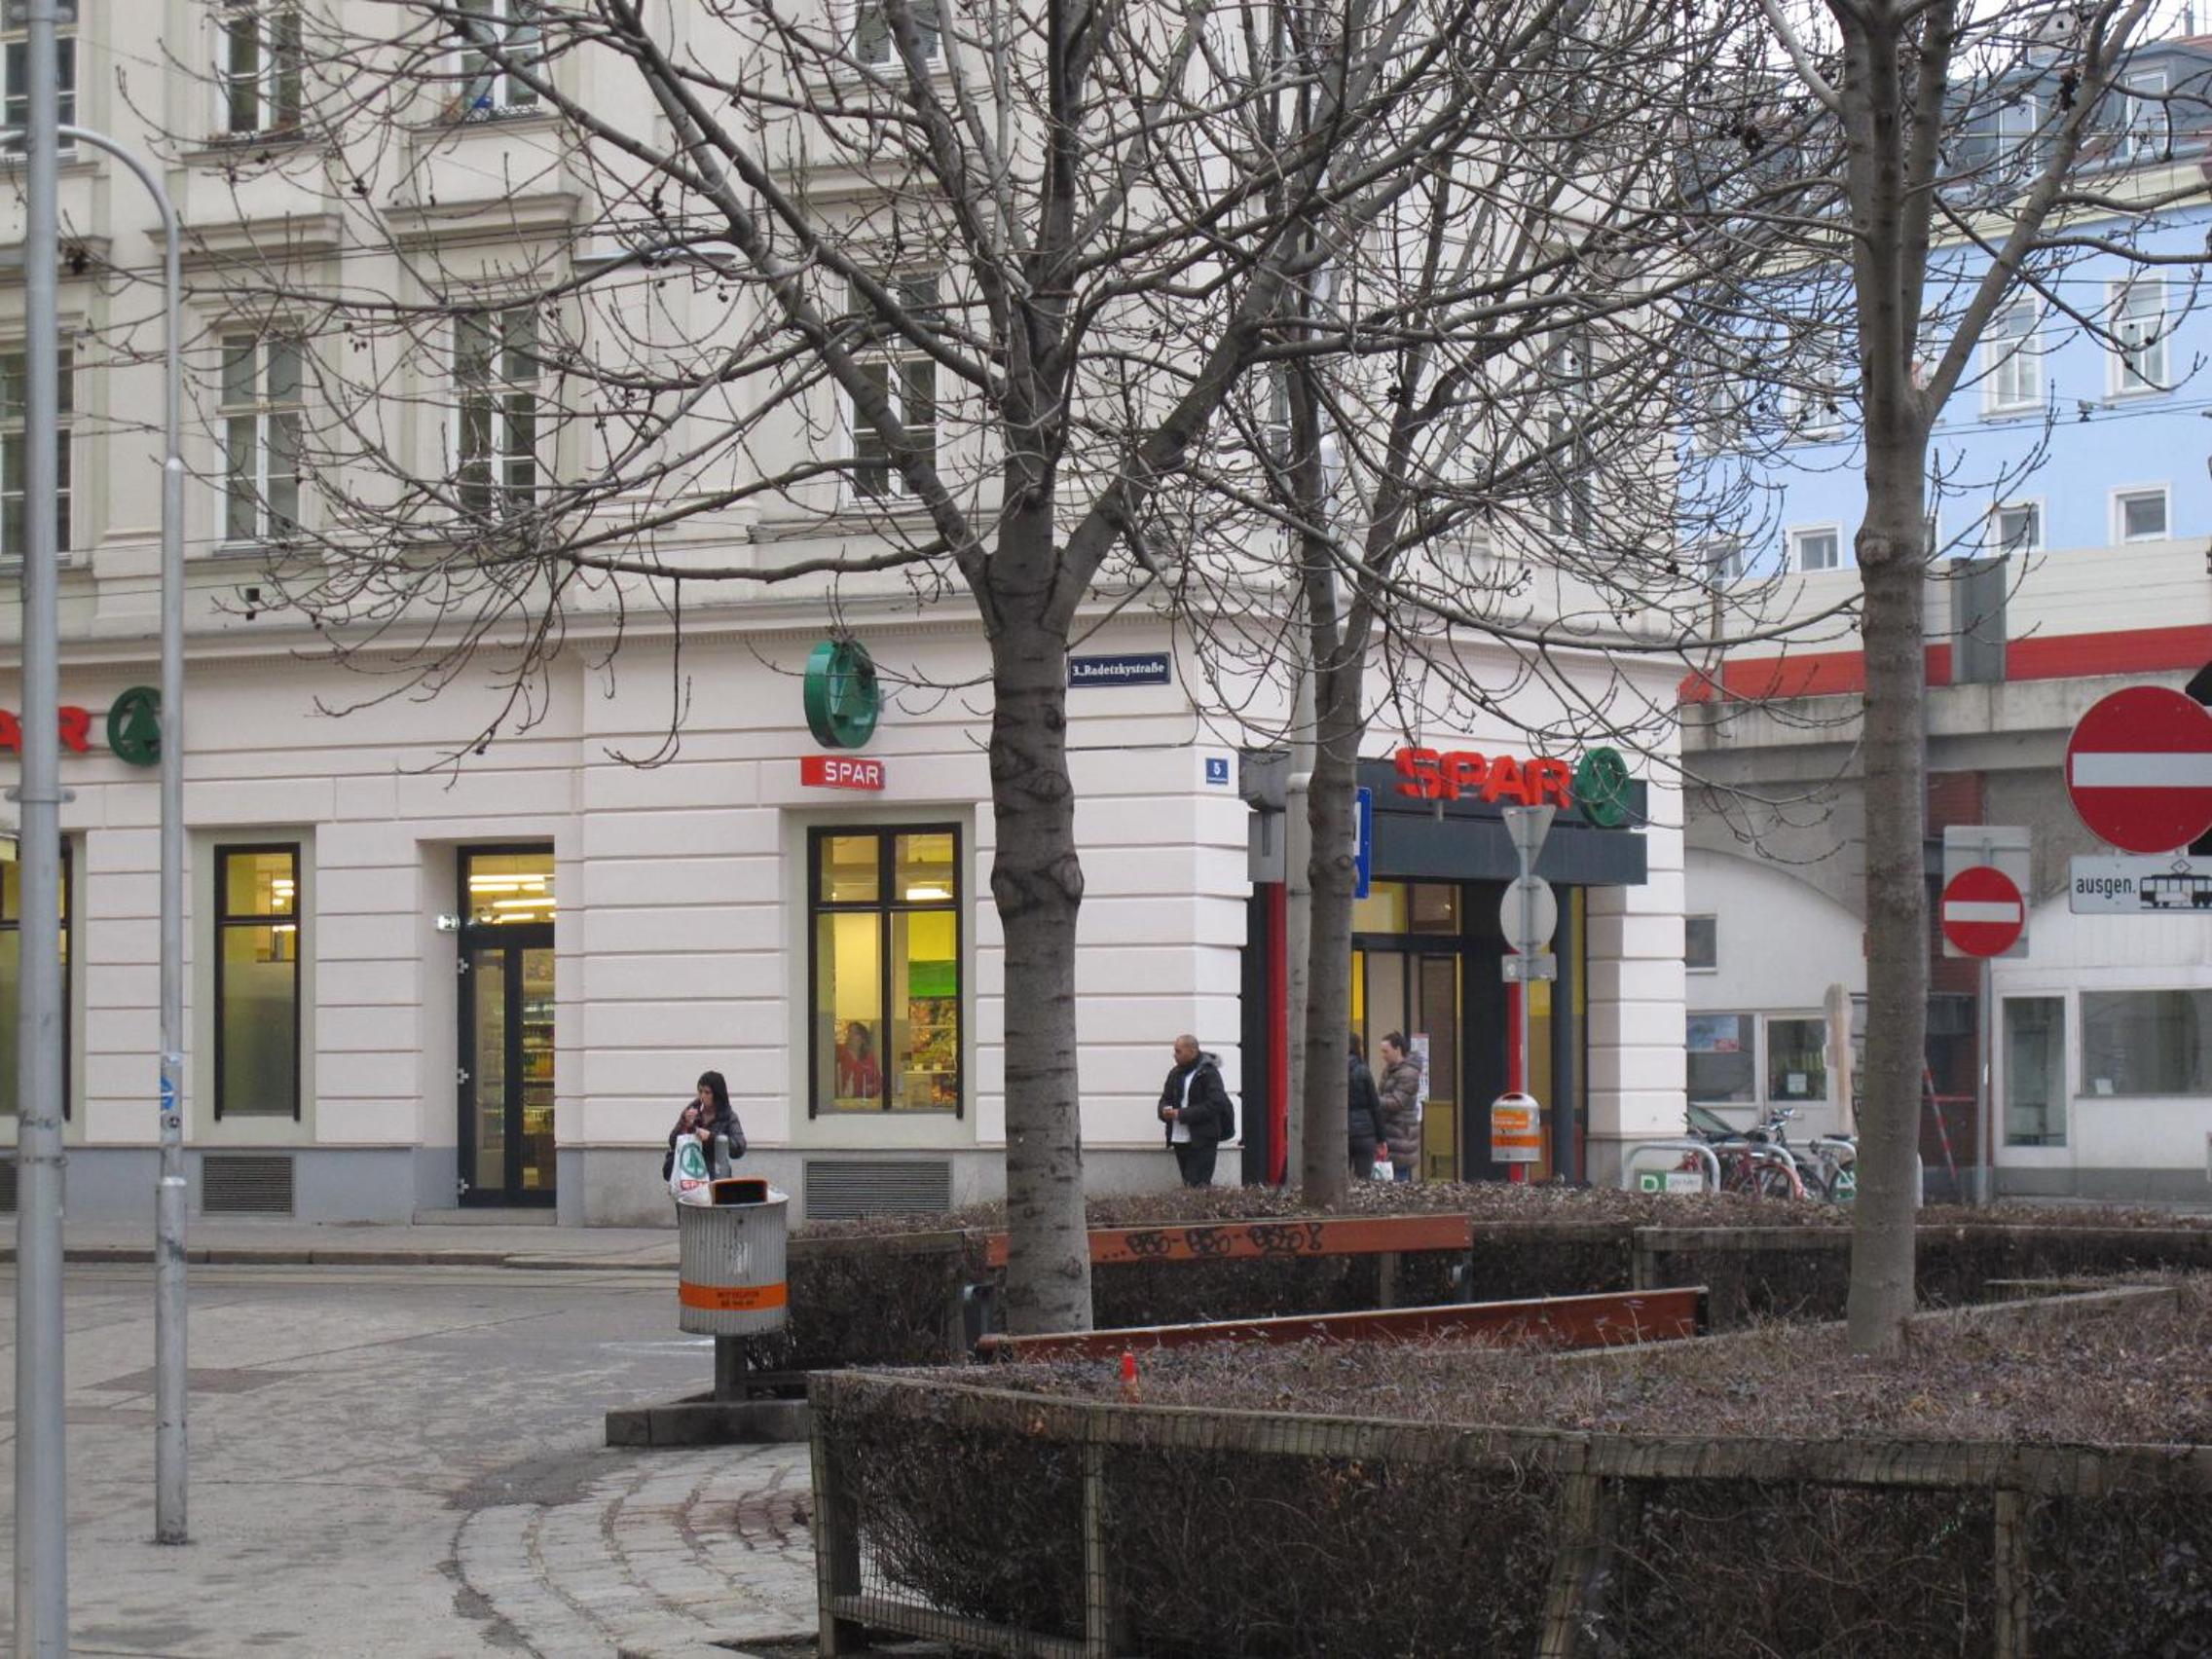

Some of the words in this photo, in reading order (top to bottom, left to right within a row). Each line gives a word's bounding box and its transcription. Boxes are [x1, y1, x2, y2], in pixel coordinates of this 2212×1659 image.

[825, 760, 879, 786] SPAR
[1214, 761, 1221, 776] 5
[1395, 747, 1572, 810] SPAR
[2076, 878, 2136, 899] ausgen.
